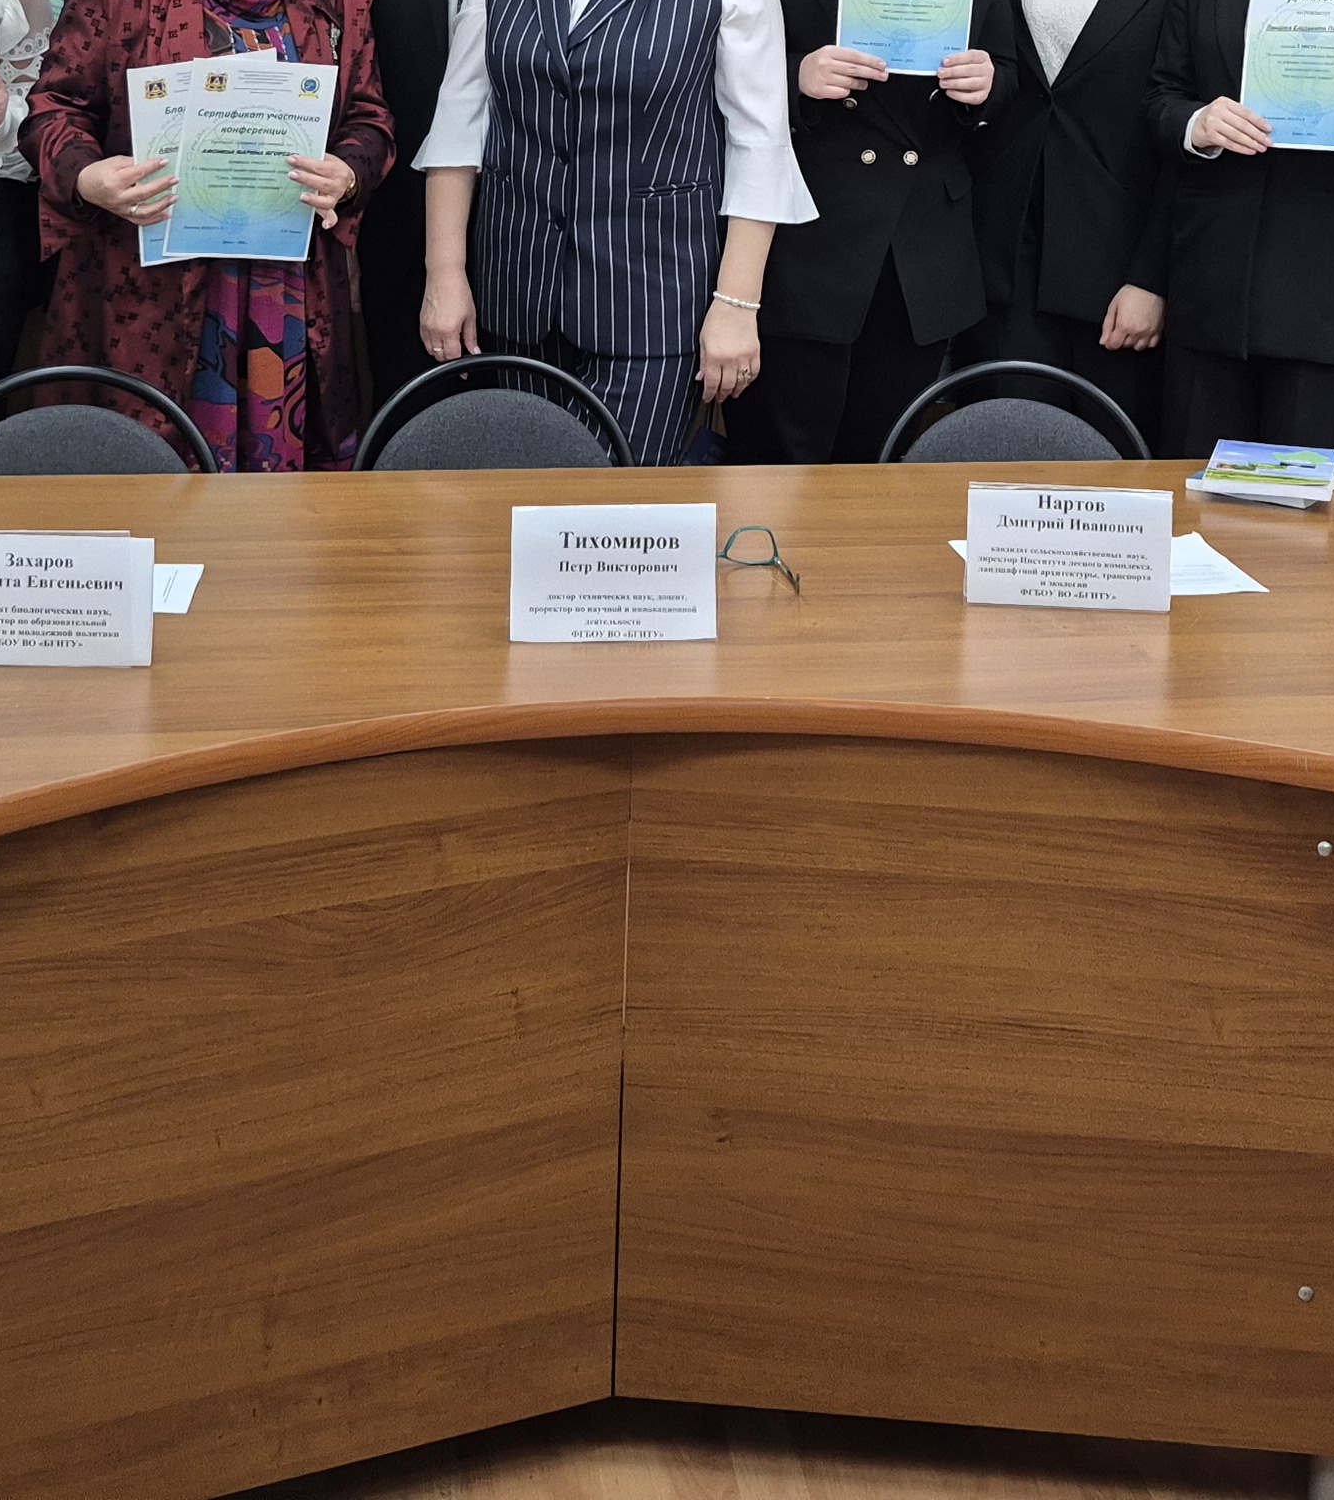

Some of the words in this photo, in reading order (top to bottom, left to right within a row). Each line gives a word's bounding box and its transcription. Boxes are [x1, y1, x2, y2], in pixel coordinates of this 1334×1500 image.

[197, 108, 264, 119] Сертификат
[267, 113, 320, 123] участника
[221, 126, 287, 136] конференции
[1038, 494, 1105, 514] Нартов
[997, 515, 1064, 532] Дмитрий
[1069, 518, 1144, 534] Иванович
[559, 531, 680, 554] Тихомиров
[5, 553, 74, 571] Захаров
[559, 561, 592, 575] Петр
[597, 561, 678, 575] Викторович
[27, 575, 123, 590] Евгеньевич
[1020, 588, 1055, 598] ФГБОУ
[1058, 590, 1071, 598] ВО
[11, 605, 84, 616] биологических
[529, 606, 572, 614] проректор
[571, 630, 604, 639] ФГБОУ
[607, 630, 620, 638] ВО
[22, 639, 36, 647] ВО
